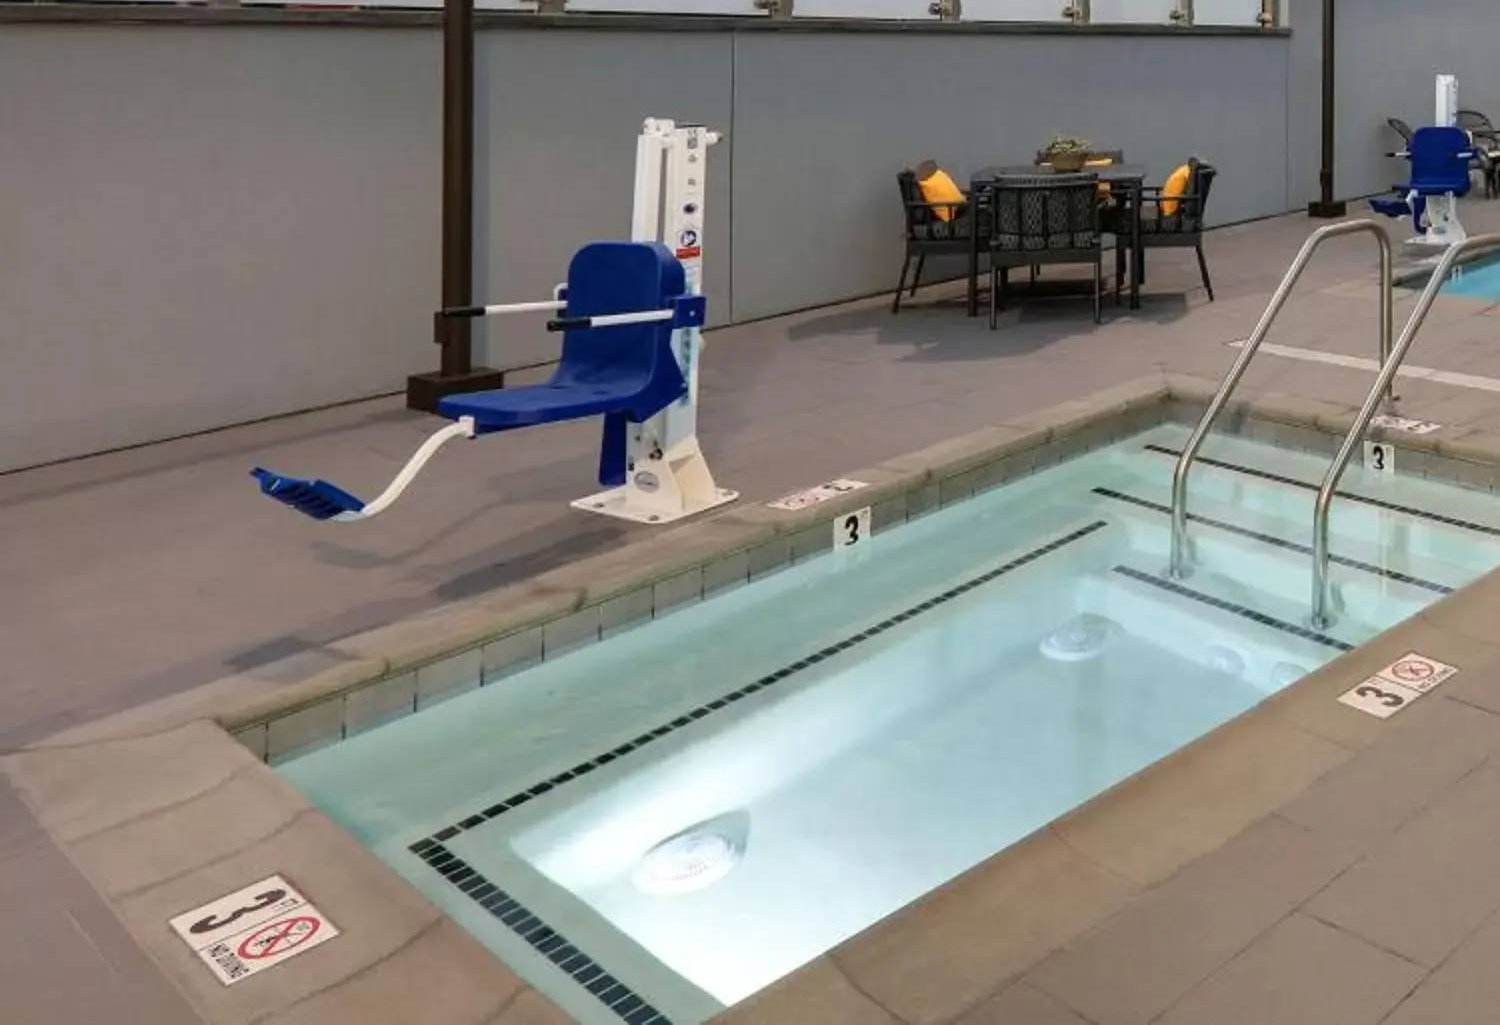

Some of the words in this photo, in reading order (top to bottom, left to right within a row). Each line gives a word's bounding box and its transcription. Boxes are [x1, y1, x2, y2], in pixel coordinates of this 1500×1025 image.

[1372, 445, 1385, 470] 3
[844, 515, 860, 546] 3
[1356, 686, 1405, 708] 3
[189, 888, 287, 935] 3
